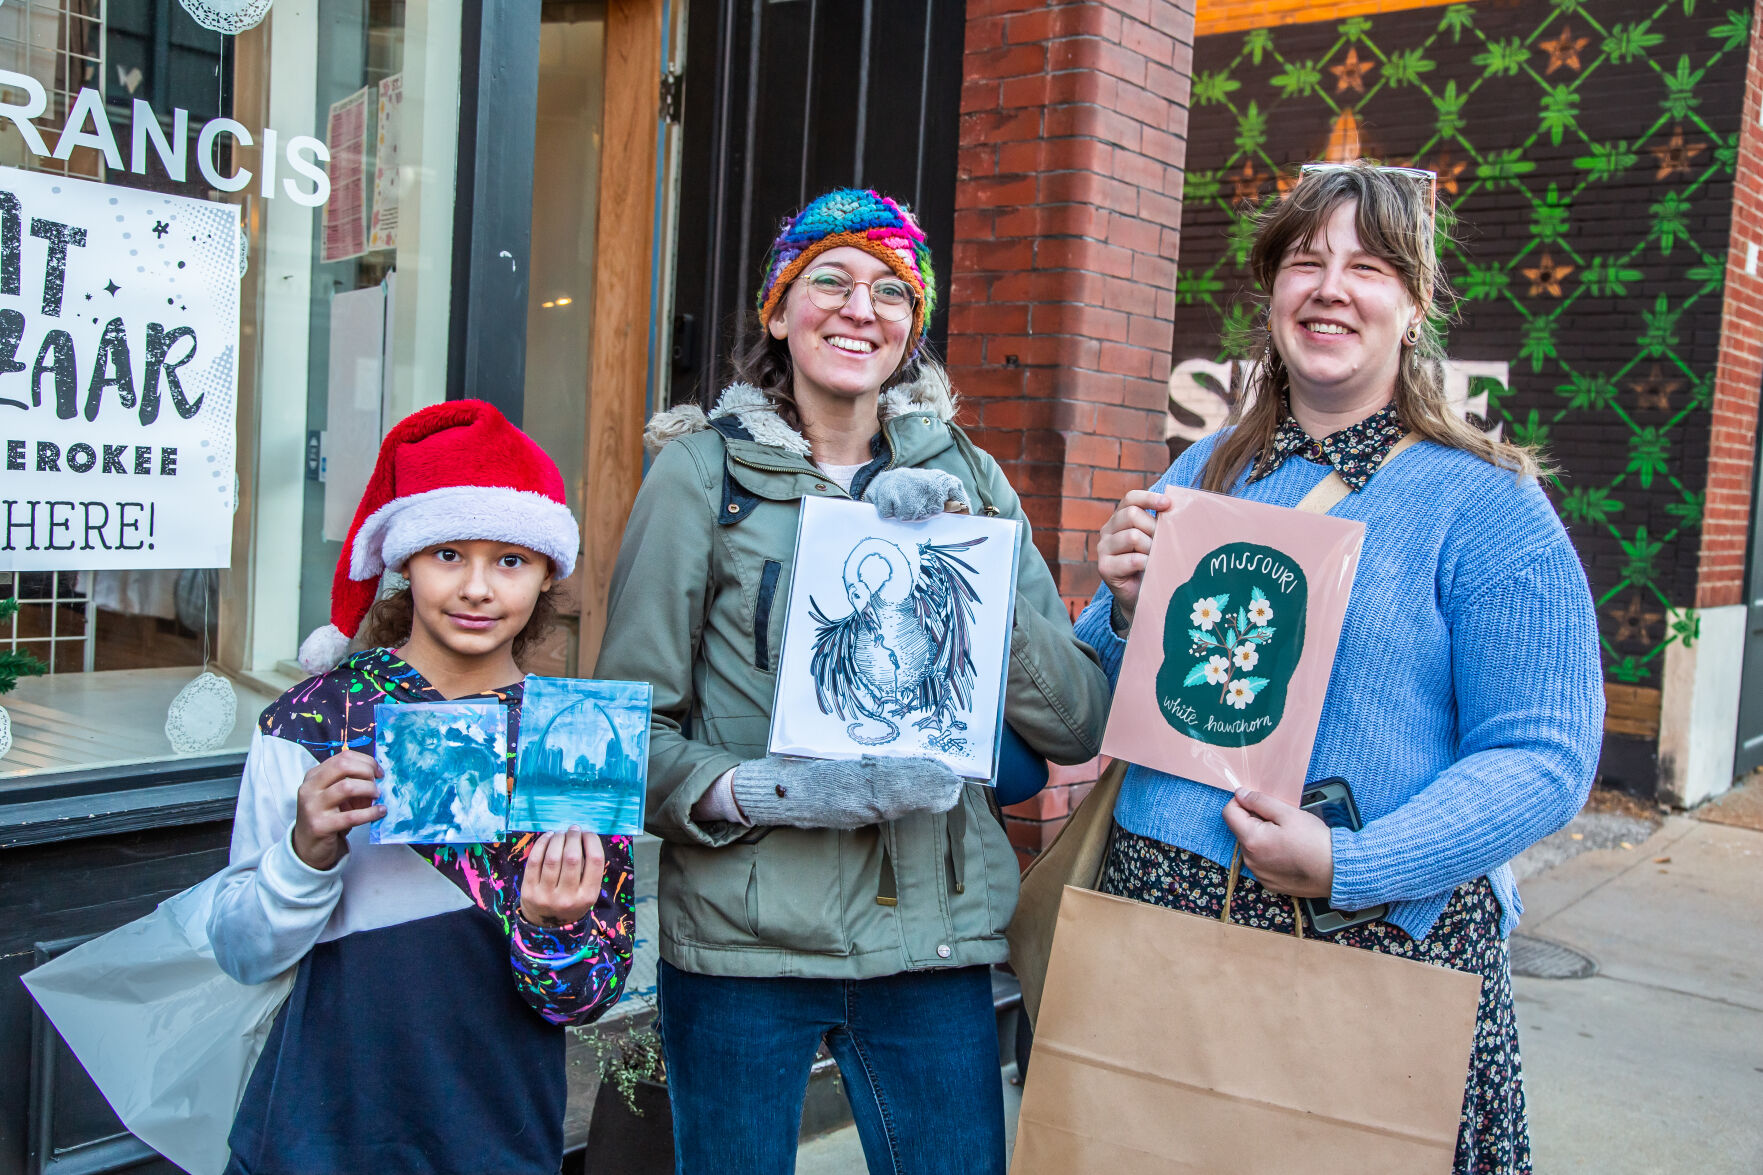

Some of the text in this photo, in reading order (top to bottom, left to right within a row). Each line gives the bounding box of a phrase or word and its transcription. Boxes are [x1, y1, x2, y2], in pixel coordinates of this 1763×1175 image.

[6, 439, 178, 476] EROKEE
[1, 499, 155, 551] HERE!
[1210, 551, 1298, 594] MISSOURI
[1163, 695, 1273, 734] white hawthorn
